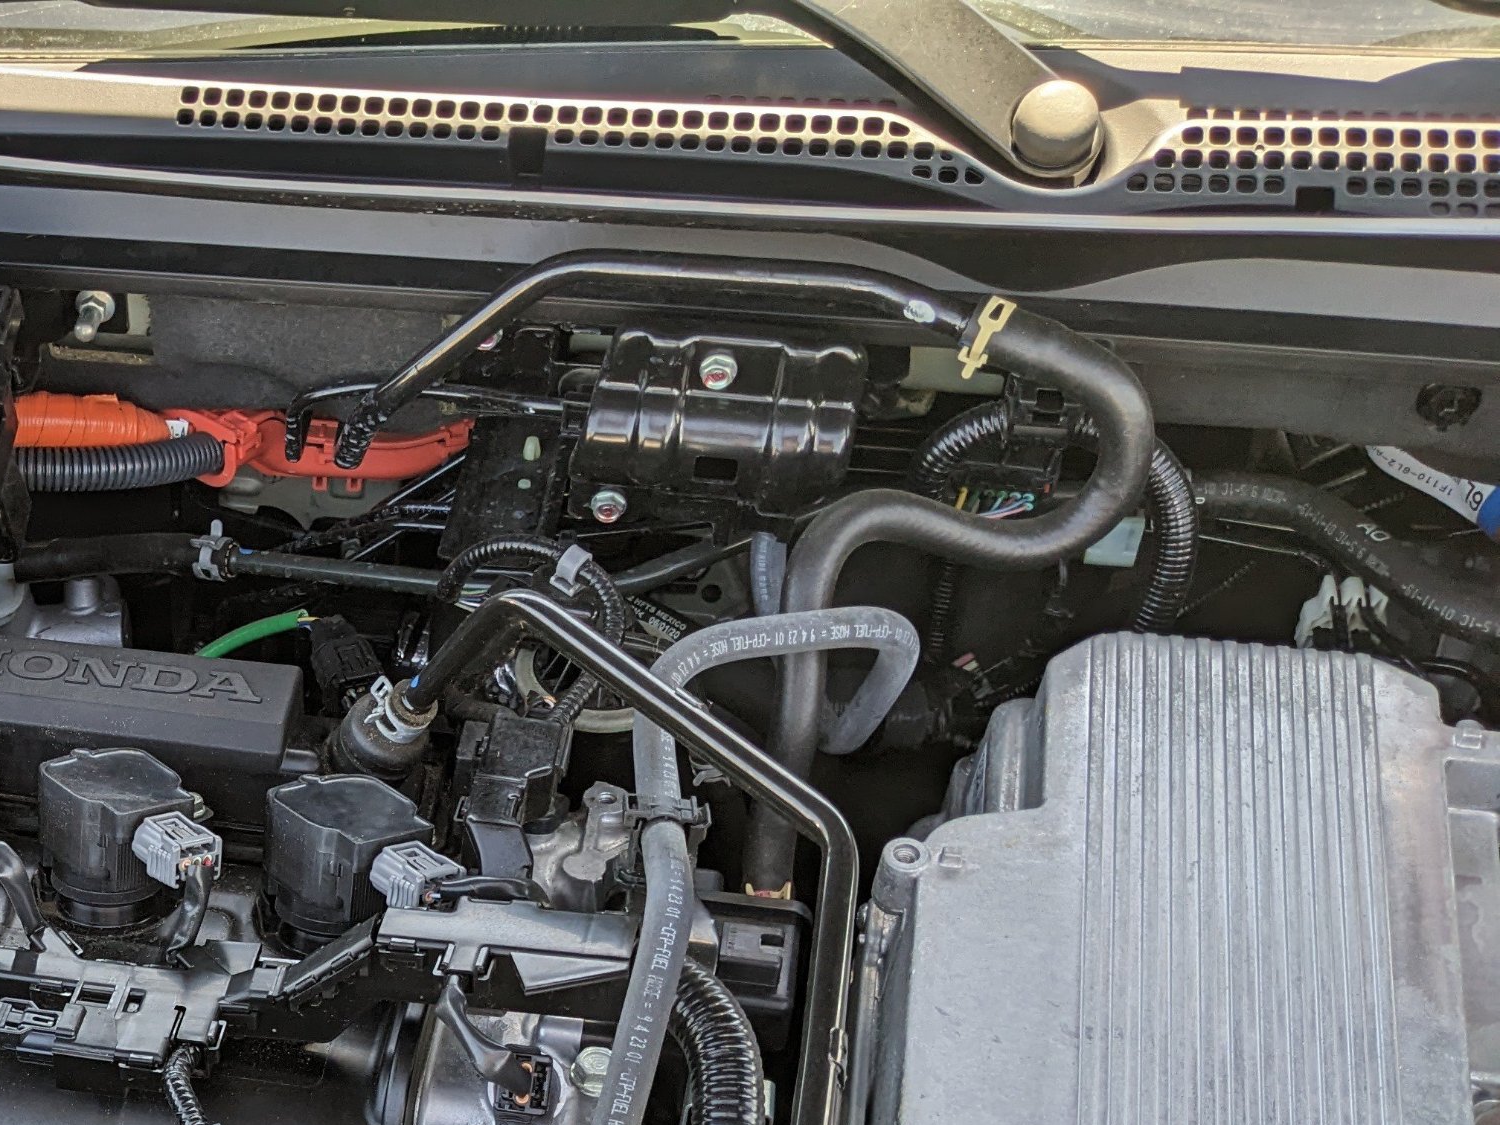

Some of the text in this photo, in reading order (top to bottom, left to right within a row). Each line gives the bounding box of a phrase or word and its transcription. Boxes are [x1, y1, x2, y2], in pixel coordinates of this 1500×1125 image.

[656, 610, 688, 631] MEXICO
[775, 631, 785, 645] 01
[788, 630, 798, 645] 23
[830, 625, 850, 640] HOSE
[709, 640, 728, 656] HOSE
[629, 1035, 647, 1049] 23
[625, 1051, 643, 1064] 01
